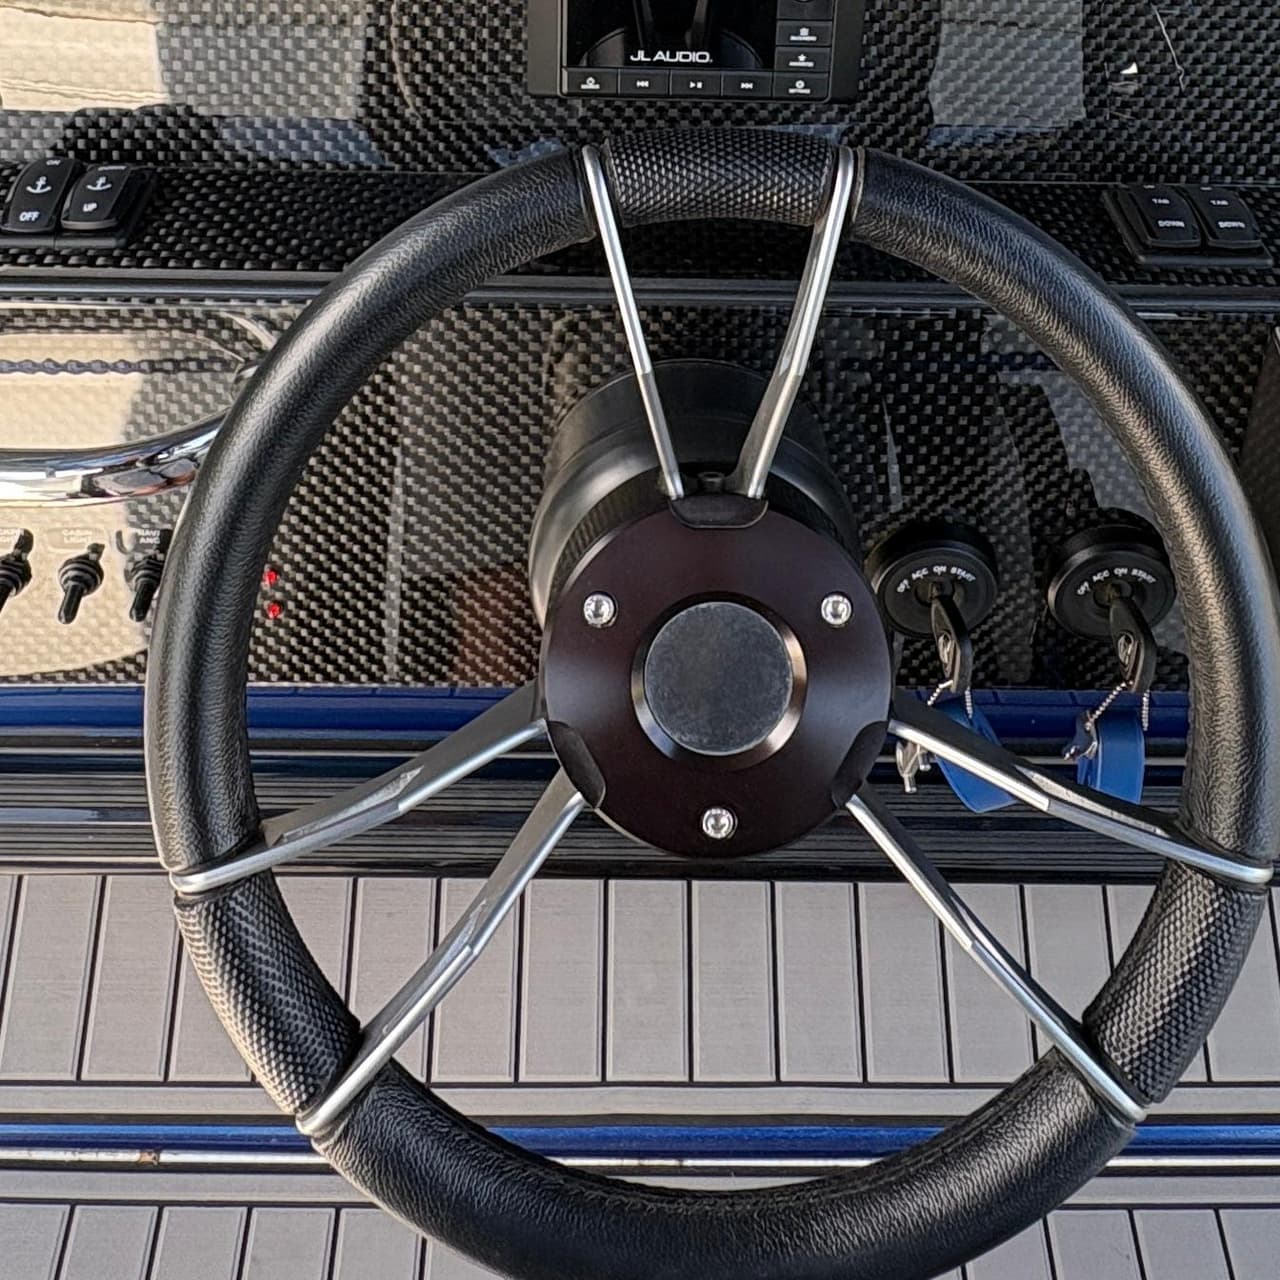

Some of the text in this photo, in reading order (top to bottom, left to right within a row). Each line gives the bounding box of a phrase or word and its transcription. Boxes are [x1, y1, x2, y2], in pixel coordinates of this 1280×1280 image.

[630, 50, 710, 63] JL AUDIO
[83, 203, 98, 212] UP
[19, 211, 40, 221] OFF
